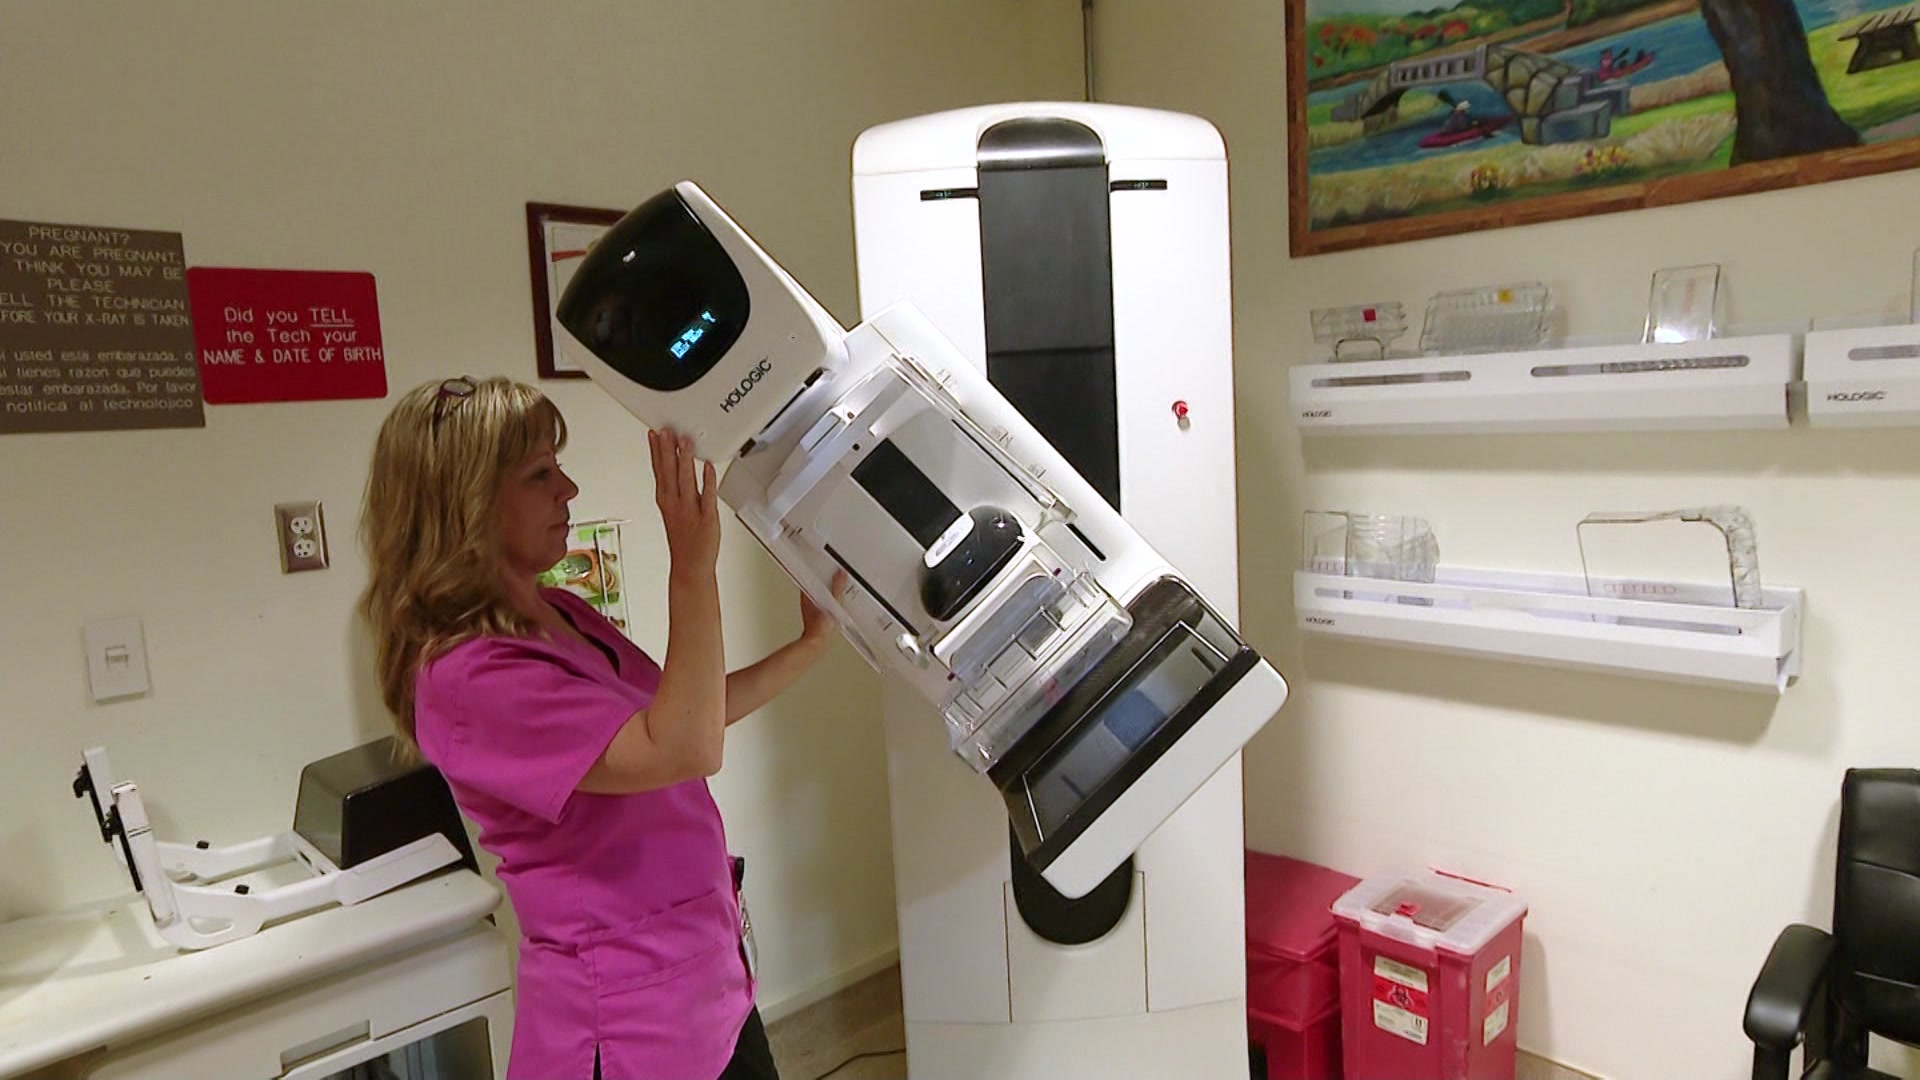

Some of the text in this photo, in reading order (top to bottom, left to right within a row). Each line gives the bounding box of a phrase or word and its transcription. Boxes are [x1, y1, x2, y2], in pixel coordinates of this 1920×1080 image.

[28, 226, 130, 245] PREGNANT?
[0, 241, 38, 256] YOU
[50, 244, 83, 260] ARE
[14, 259, 184, 280] THINK YOU MAY BE
[46, 278, 117, 294] PLEASE
[47, 294, 81, 310] THE
[92, 296, 186, 312] TECHNICIAN
[44, 310, 79, 325] YOUR
[151, 313, 190, 327] TAKEN
[224, 306, 356, 325] Did you TELL
[226, 328, 357, 345] the Tech your
[14, 349, 53, 362] usted
[203, 346, 383, 365] NAME & DATE OF BIRTH
[117, 366, 142, 379] que
[148, 364, 196, 379] puedes
[136, 380, 158, 394] Por
[719, 358, 772, 413] HOLOGIC
[79, 398, 93, 412] al
